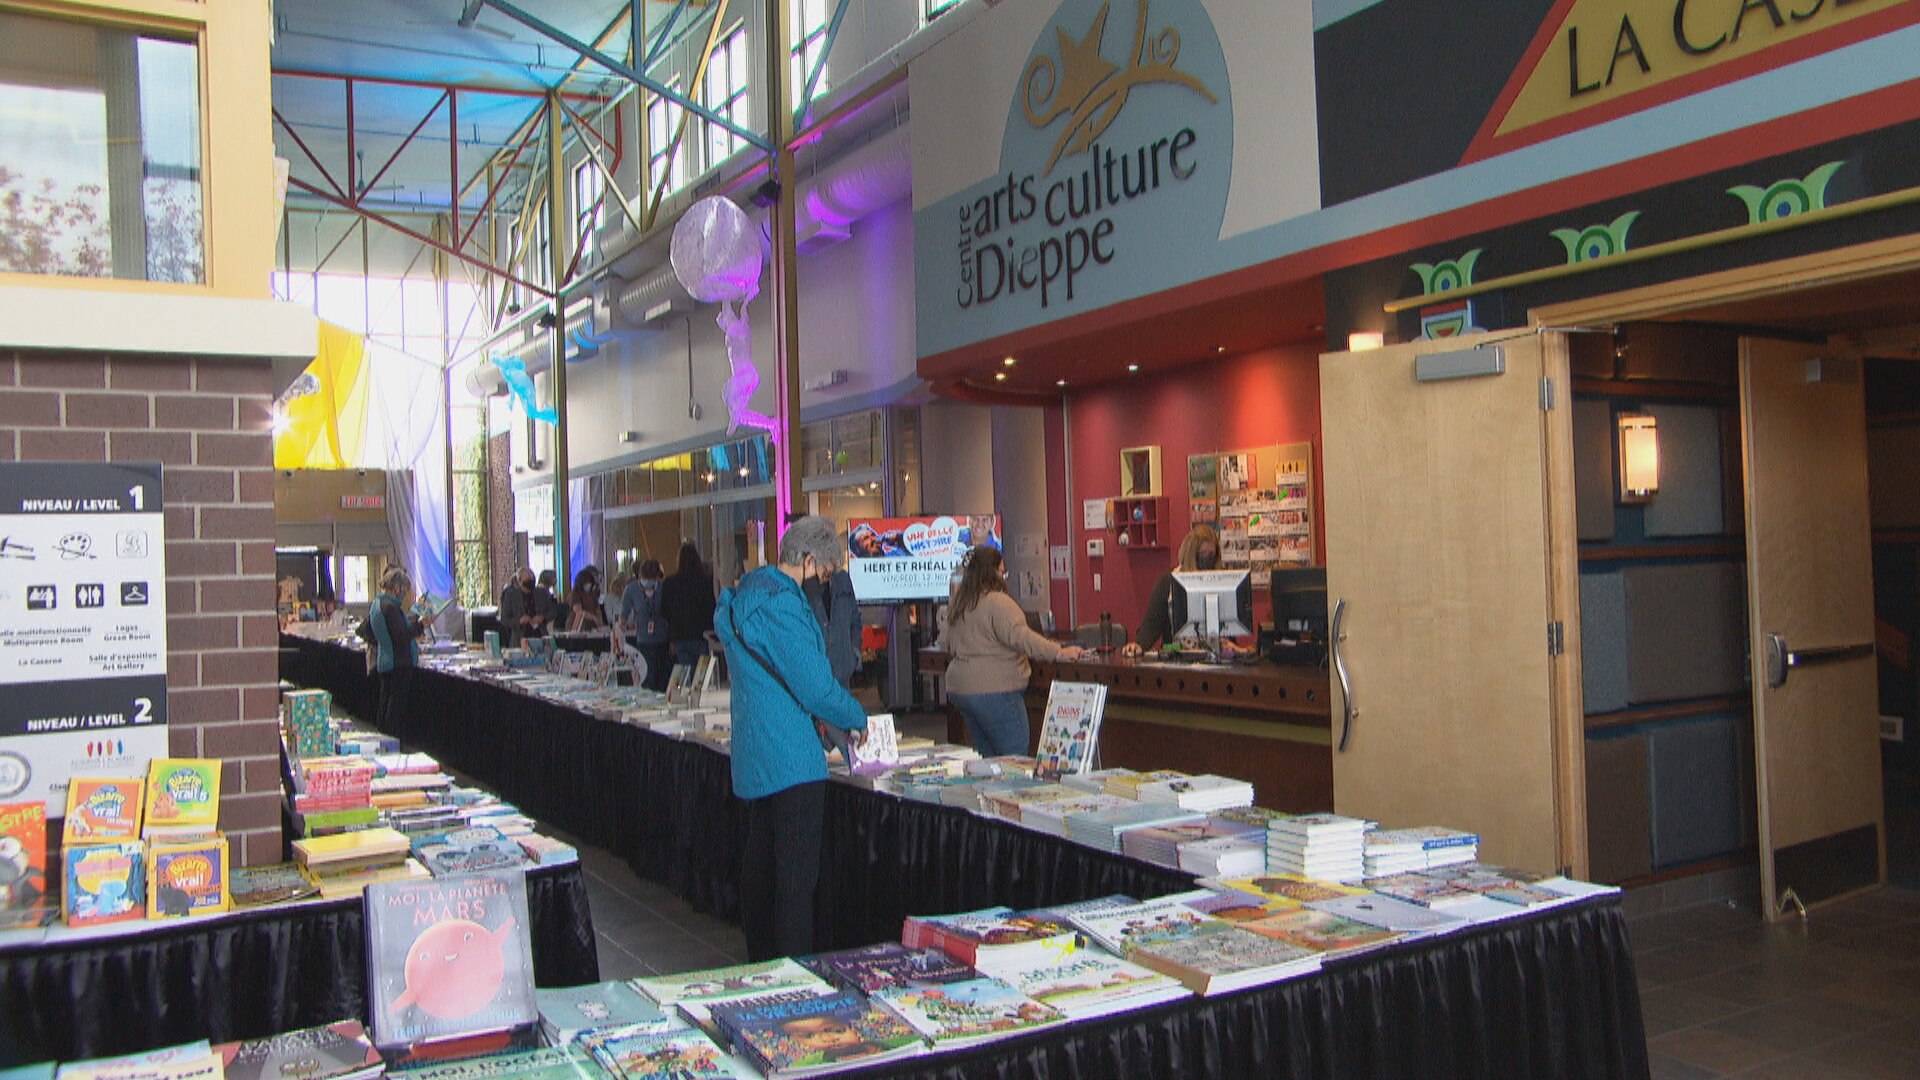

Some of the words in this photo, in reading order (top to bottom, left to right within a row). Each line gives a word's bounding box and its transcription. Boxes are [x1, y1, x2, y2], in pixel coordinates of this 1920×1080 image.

[1567, 12, 1652, 99] LA
[973, 170, 1037, 238] arts
[1045, 127, 1198, 226] culture
[957, 203, 974, 309] centre
[976, 216, 1116, 308] Dieppe
[22, 499, 73, 511] NIVEAU
[82, 499, 121, 511] LEVEL
[129, 485, 145, 512] 1
[896, 561, 907, 573] ET
[3, 637, 58, 647] Multipurpose
[61, 636, 84, 644] Room
[104, 634, 127, 642] Green
[30, 657, 63, 666] Caserne
[89, 655, 108, 663] Salle
[102, 663, 115, 671] Art
[117, 662, 145, 671] Gallery
[26, 717, 77, 732] NIVEAU
[88, 713, 126, 727] LEVEL
[134, 697, 153, 724] 2
[92, 802, 121, 818] vrai!
[171, 859, 208, 875] Bizarre
[176, 873, 205, 888] vrai!
[388, 892, 425, 907] MOI,
[430, 891, 445, 902] LA
[449, 883, 508, 899] PLANÈTE
[413, 900, 487, 927] MARS
